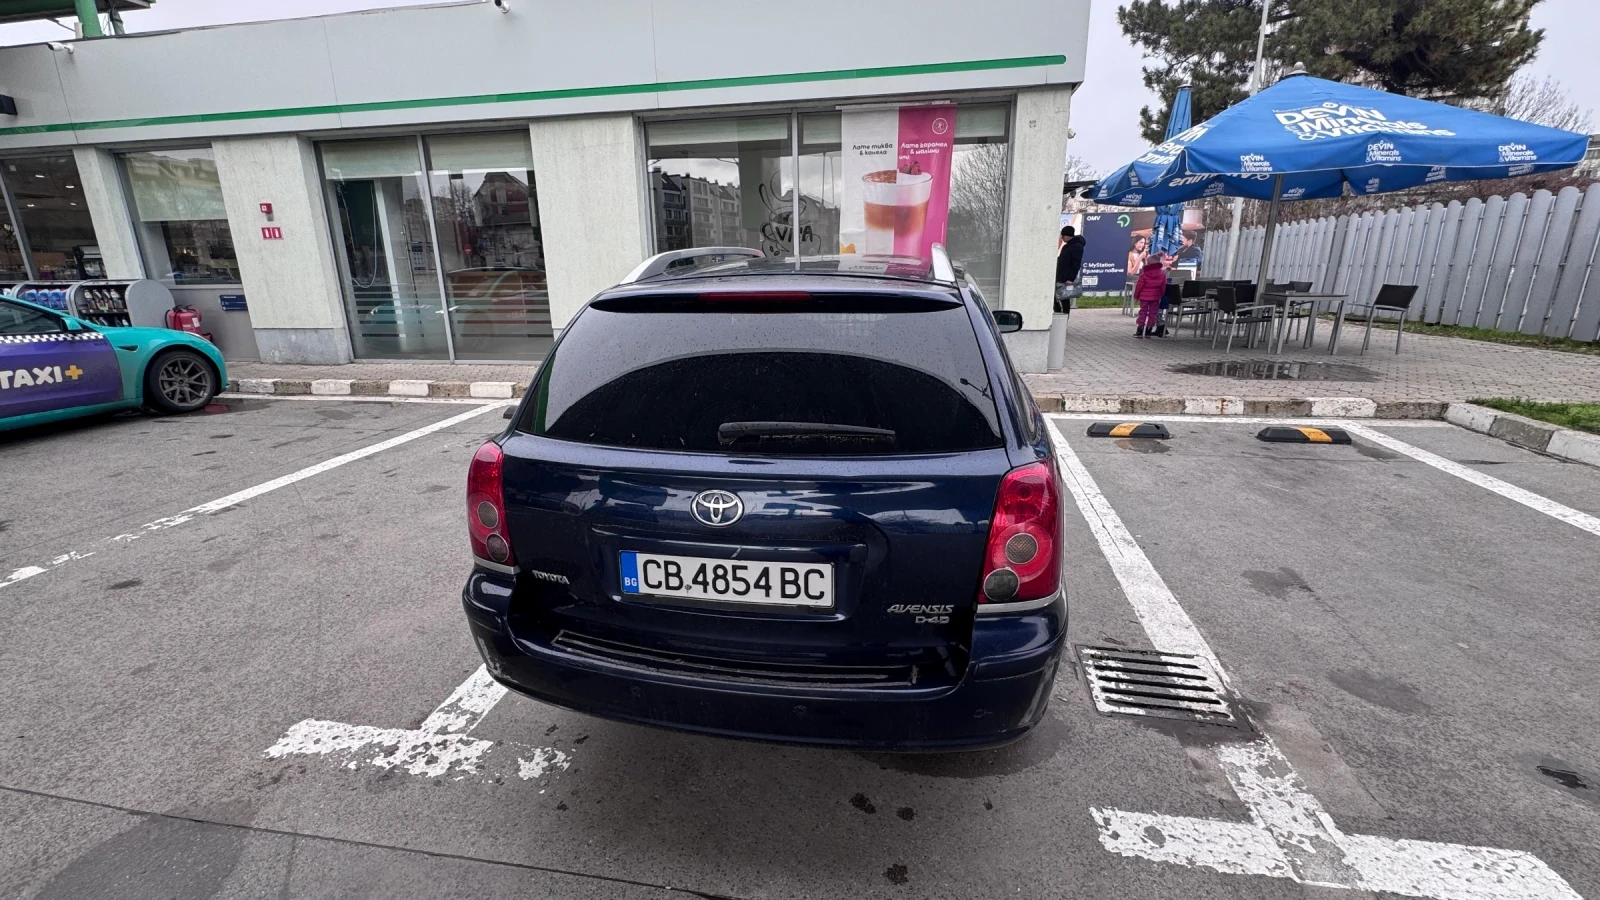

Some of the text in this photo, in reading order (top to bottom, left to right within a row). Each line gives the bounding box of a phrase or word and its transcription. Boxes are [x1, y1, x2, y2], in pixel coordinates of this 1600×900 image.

[1274, 103, 1387, 125] DEVIN
[871, 142, 893, 150] тиква
[920, 141, 948, 149] карамел
[1367, 142, 1394, 151] DEVIN
[1498, 144, 1527, 152] DEVIN
[1369, 149, 1400, 157] Minerals
[775, 225, 813, 243] VIA
[531, 569, 570, 585] TOYOTA
[624, 576, 638, 587] BG
[642, 558, 826, 601] CB 4854 BC
[886, 603, 955, 614] AVENSIS
[914, 615, 950, 624] D-4D
